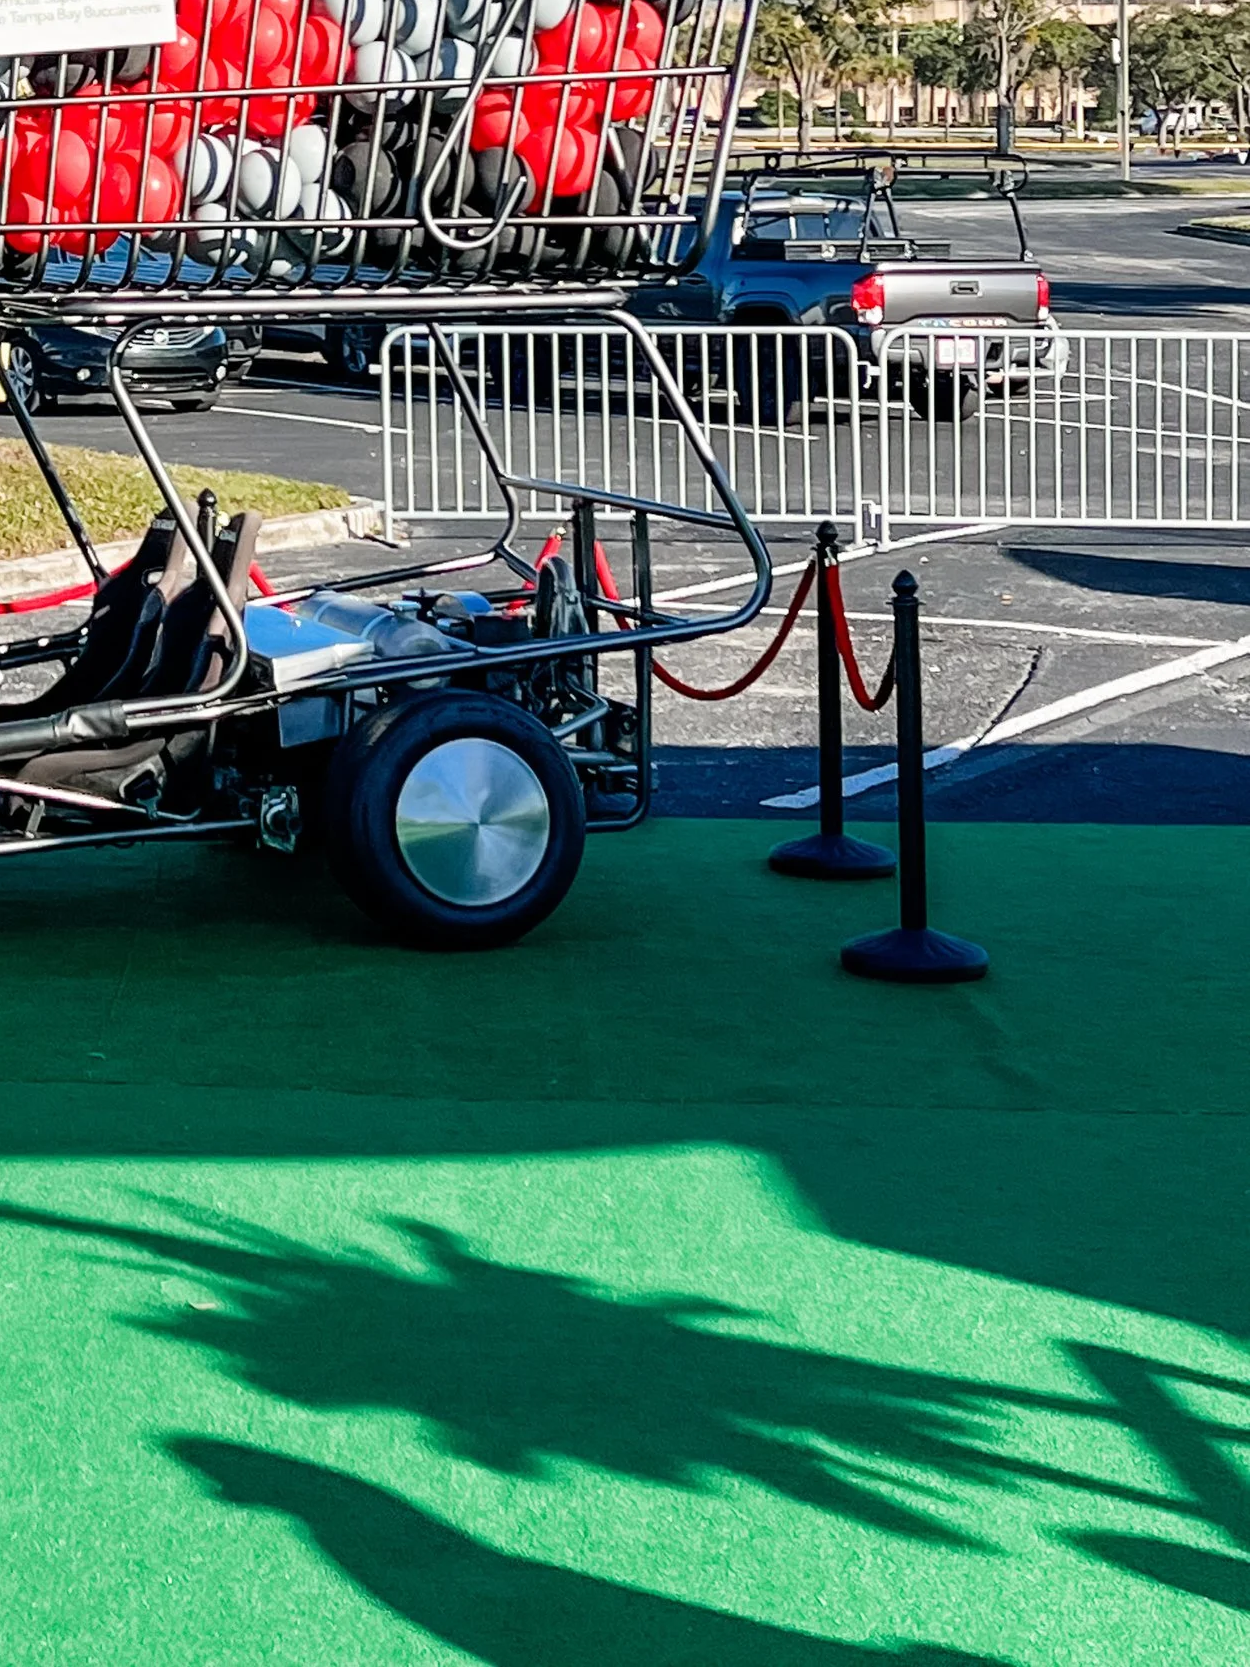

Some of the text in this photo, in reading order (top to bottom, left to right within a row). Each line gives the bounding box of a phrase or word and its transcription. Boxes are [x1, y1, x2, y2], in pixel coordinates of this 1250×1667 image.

[9, 8, 54, 26] Tampa
[57, 6, 82, 23] Bay
[84, 2, 161, 19] Buccaneers
